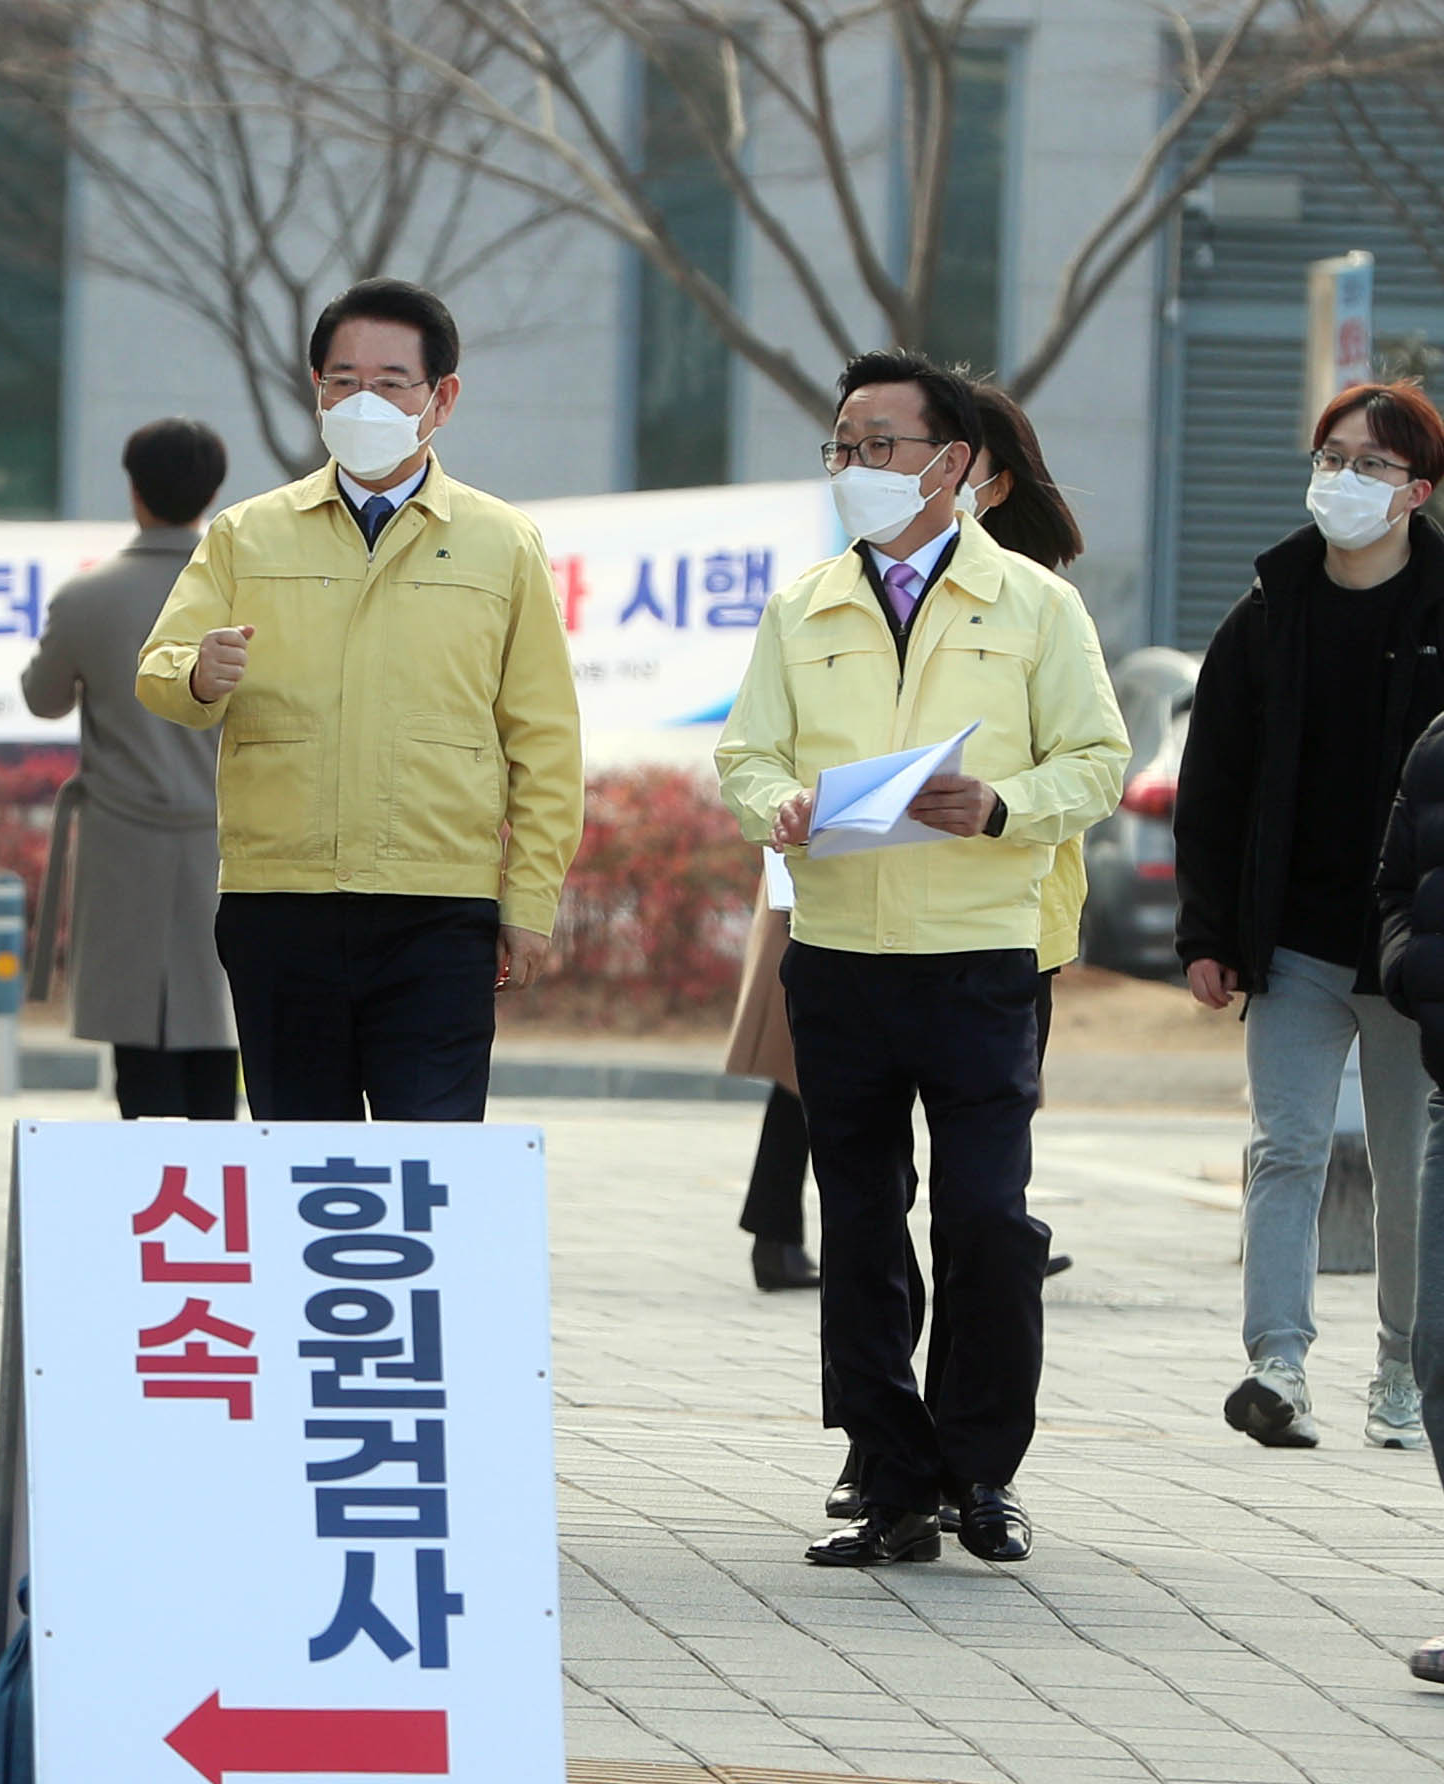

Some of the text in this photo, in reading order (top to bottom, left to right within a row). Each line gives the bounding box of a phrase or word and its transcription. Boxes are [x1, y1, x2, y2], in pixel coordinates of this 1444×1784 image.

[618, 547, 772, 630] 시행
[133, 1165, 259, 1420] 신속
[290, 1156, 465, 1670] 항원검사
